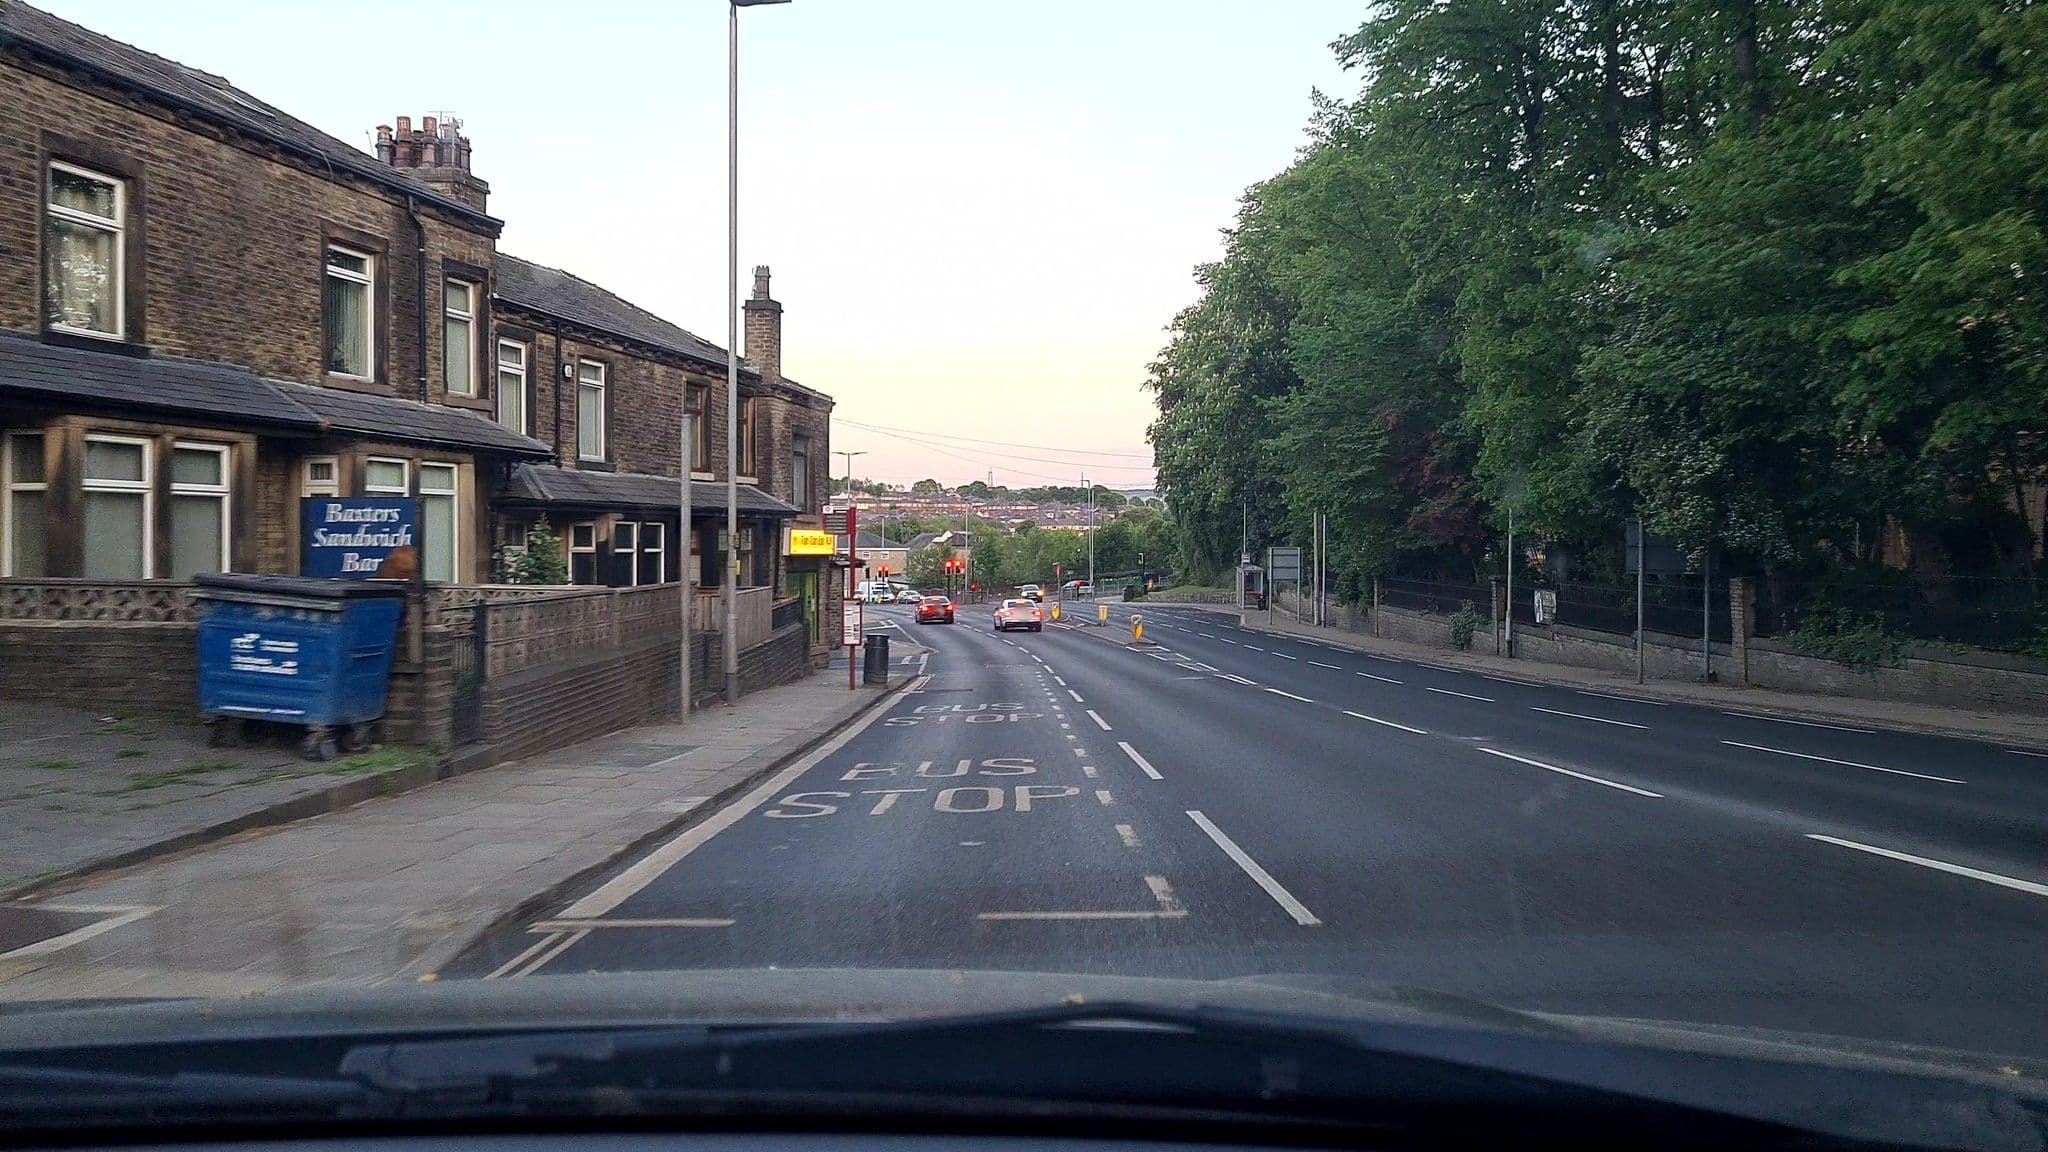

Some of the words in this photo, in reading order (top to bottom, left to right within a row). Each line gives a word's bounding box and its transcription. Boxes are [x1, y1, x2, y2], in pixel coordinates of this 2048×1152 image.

[325, 503, 401, 522] Baxters
[311, 524, 412, 547] Sandwich
[341, 552, 384, 572] Bar
[913, 702, 1025, 714] BUS
[884, 713, 1044, 727] STOP
[840, 758, 1037, 781] BUS
[763, 785, 1080, 818] STOP
